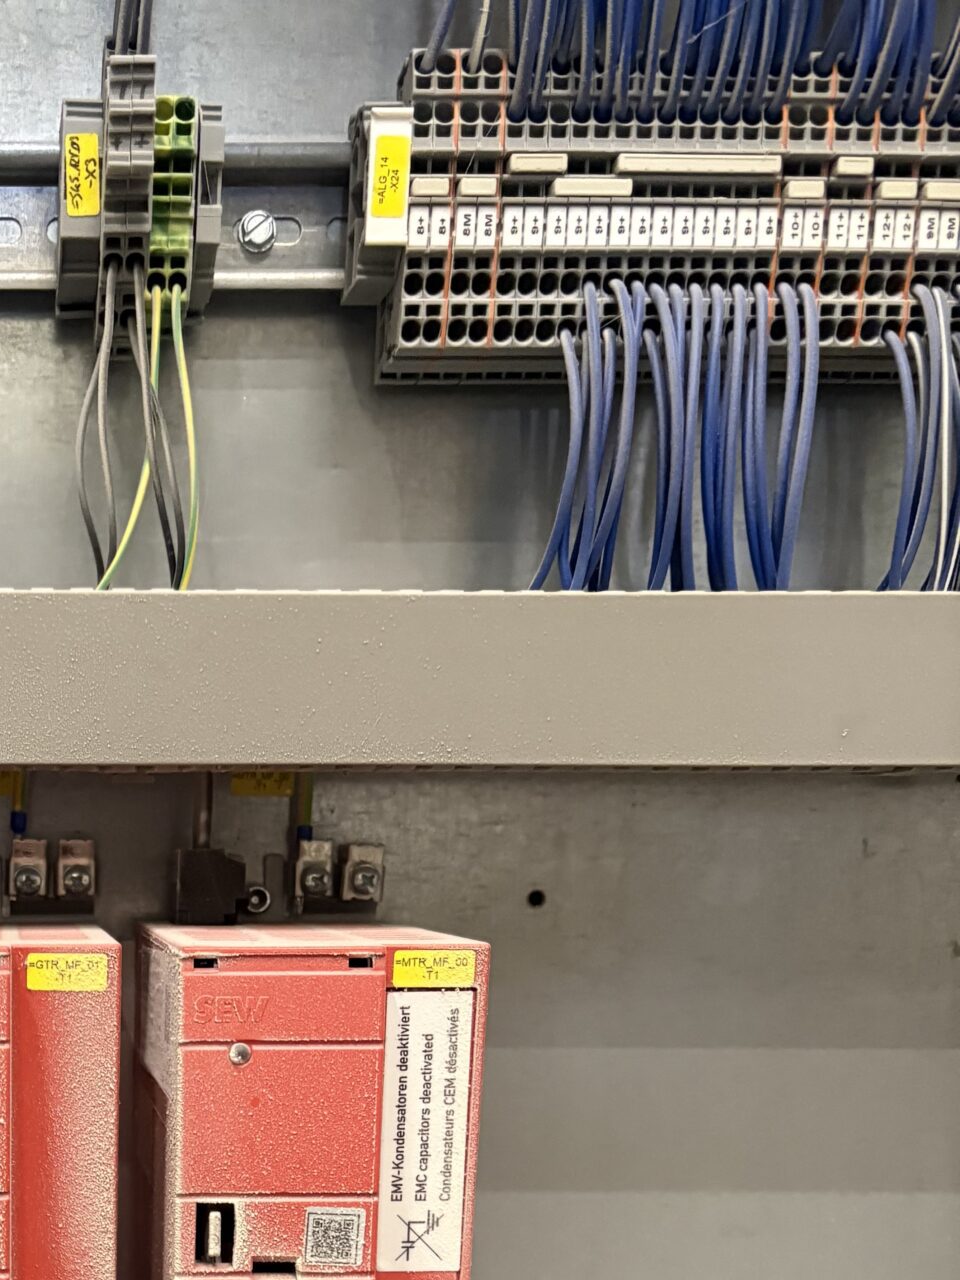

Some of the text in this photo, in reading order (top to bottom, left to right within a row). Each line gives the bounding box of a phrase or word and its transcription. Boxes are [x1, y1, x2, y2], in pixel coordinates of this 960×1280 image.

[377, 157, 390, 204] =ALG_14
[390, 169, 399, 192] -X24
[193, 995, 269, 1024] SEW
[391, 1005, 411, 1202] EMV-Kondensatoren deaktiviert
[415, 1033, 434, 1202] EMC capacitors deactivated
[439, 1008, 460, 1201] Condensateurs CEM désactivés
